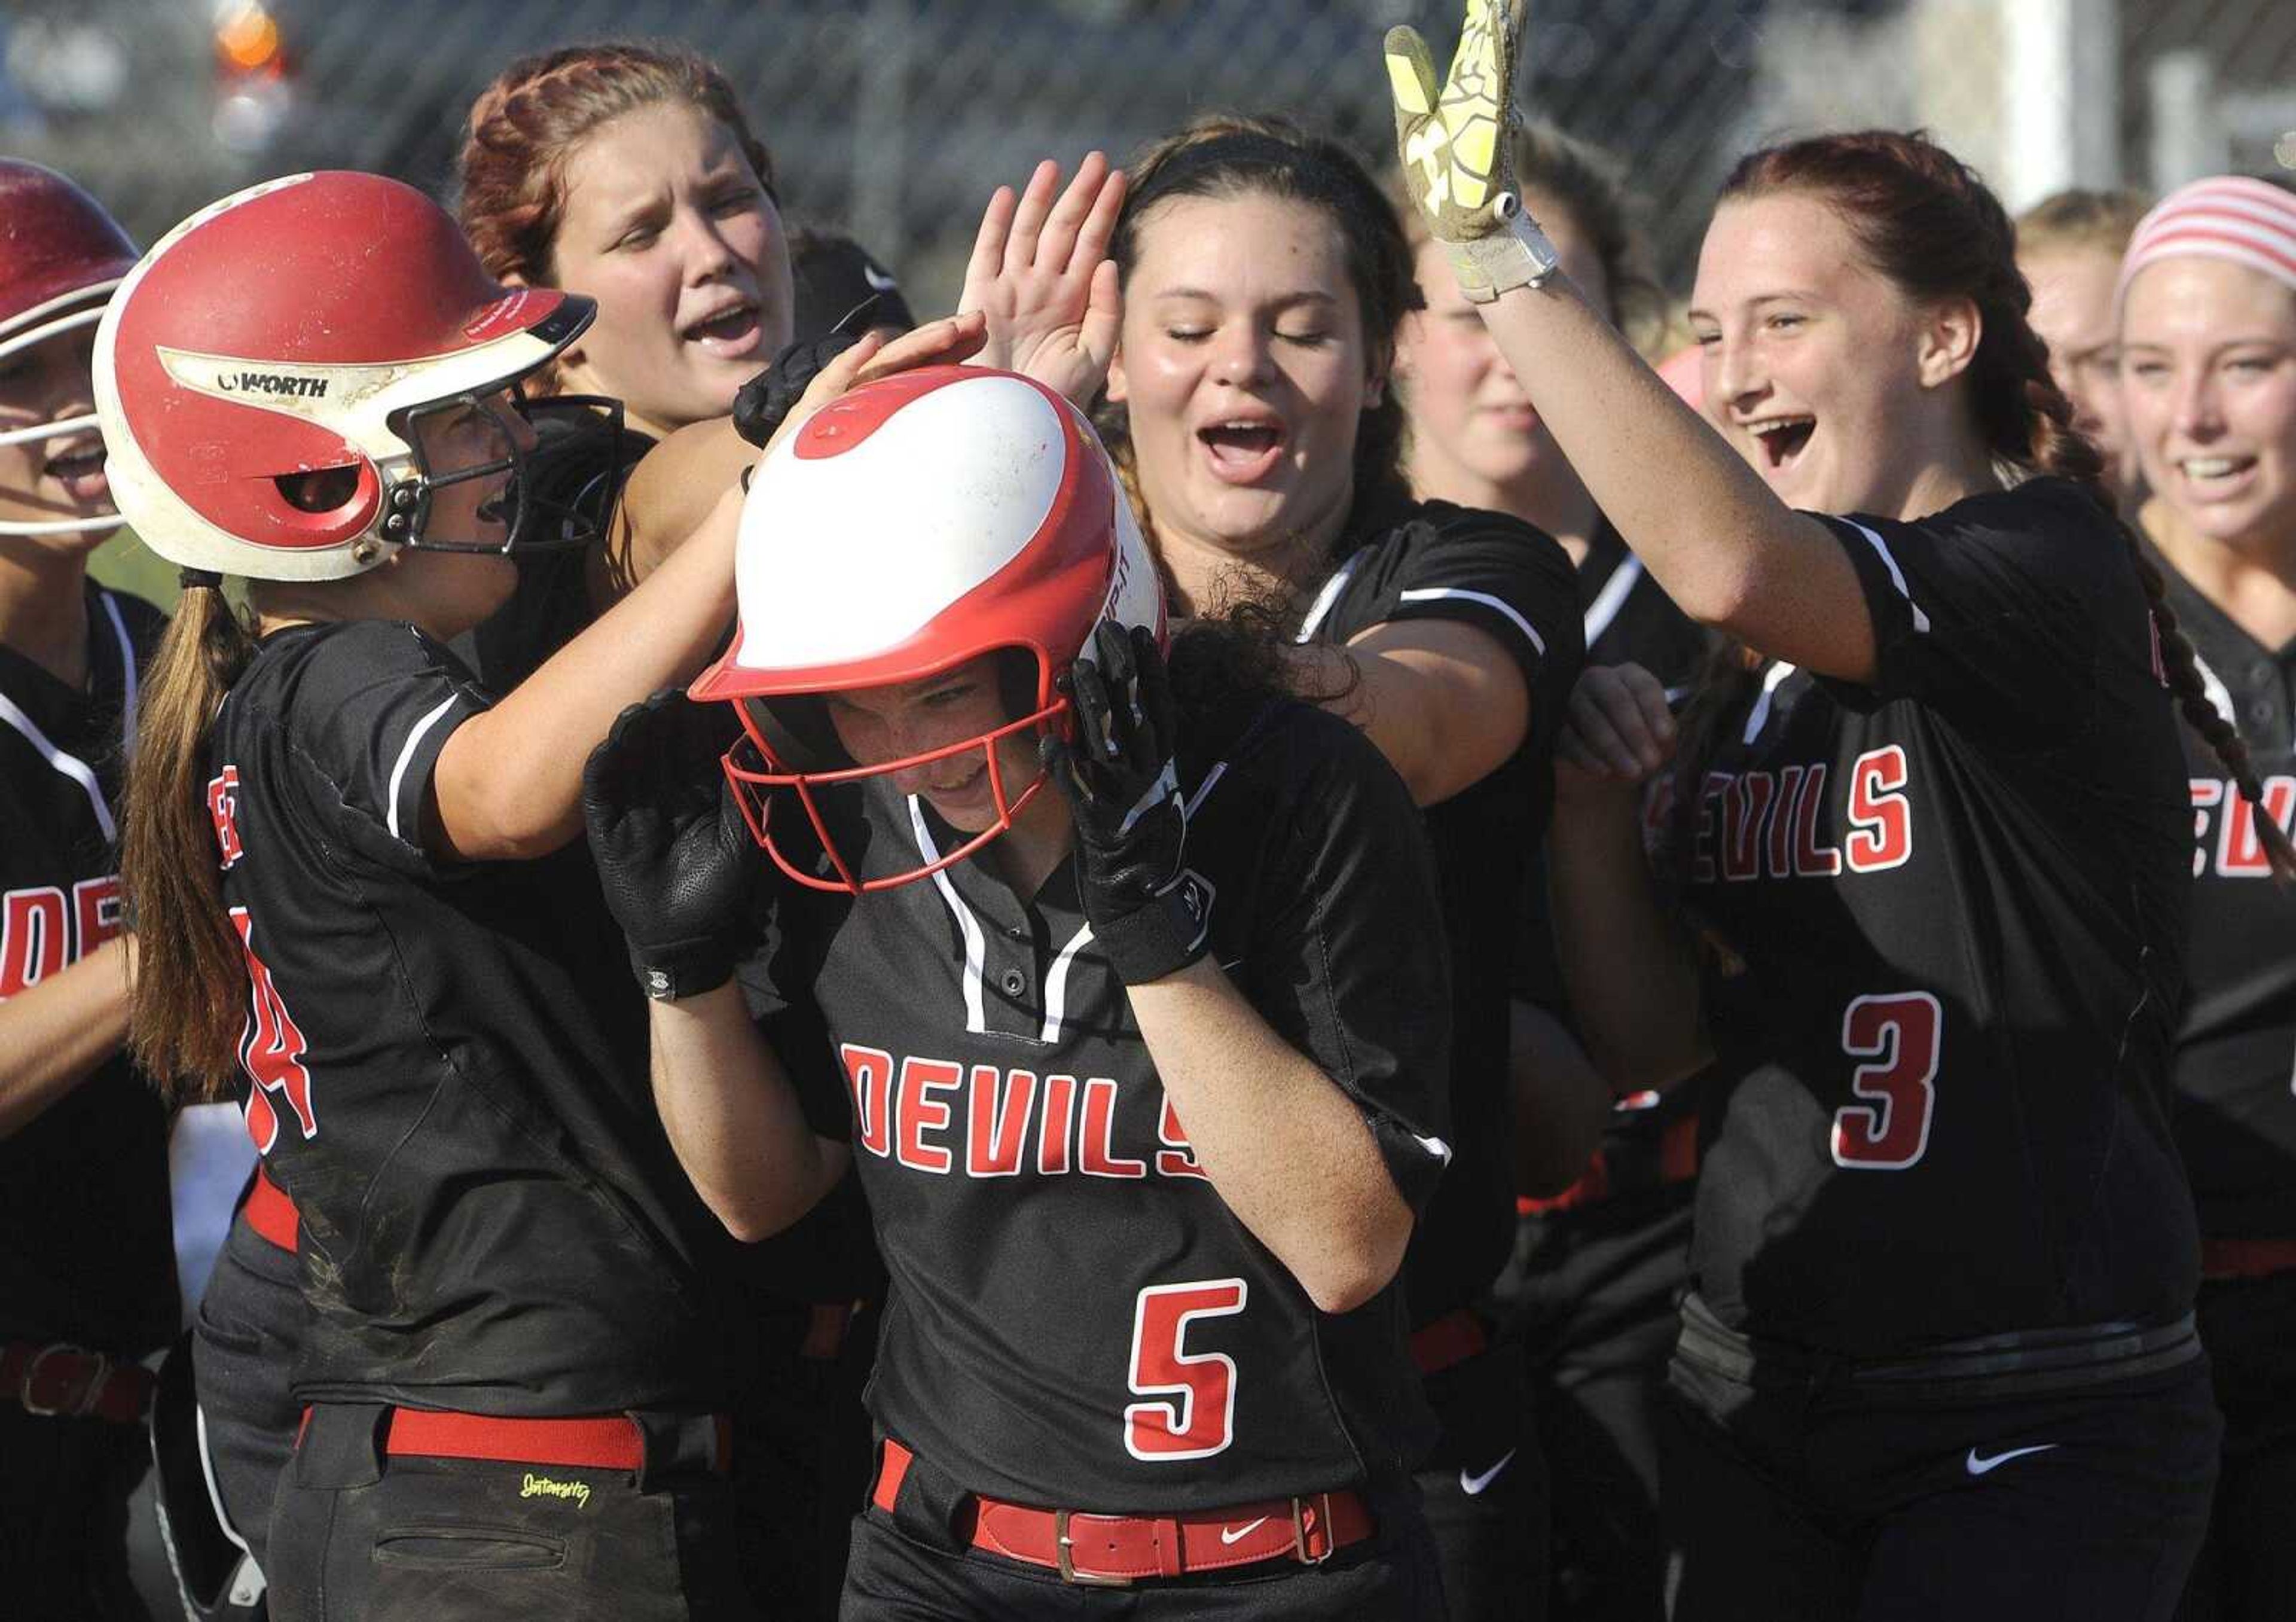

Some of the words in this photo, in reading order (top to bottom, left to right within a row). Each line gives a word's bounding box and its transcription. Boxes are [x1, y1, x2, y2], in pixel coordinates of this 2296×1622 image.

[240, 373, 328, 397] WORTH
[1099, 544, 1130, 623] IP-IT
[1830, 990, 1942, 1169] 3
[1123, 1277, 1248, 1461] 5
[520, 1472, 591, 1510] Intensity
